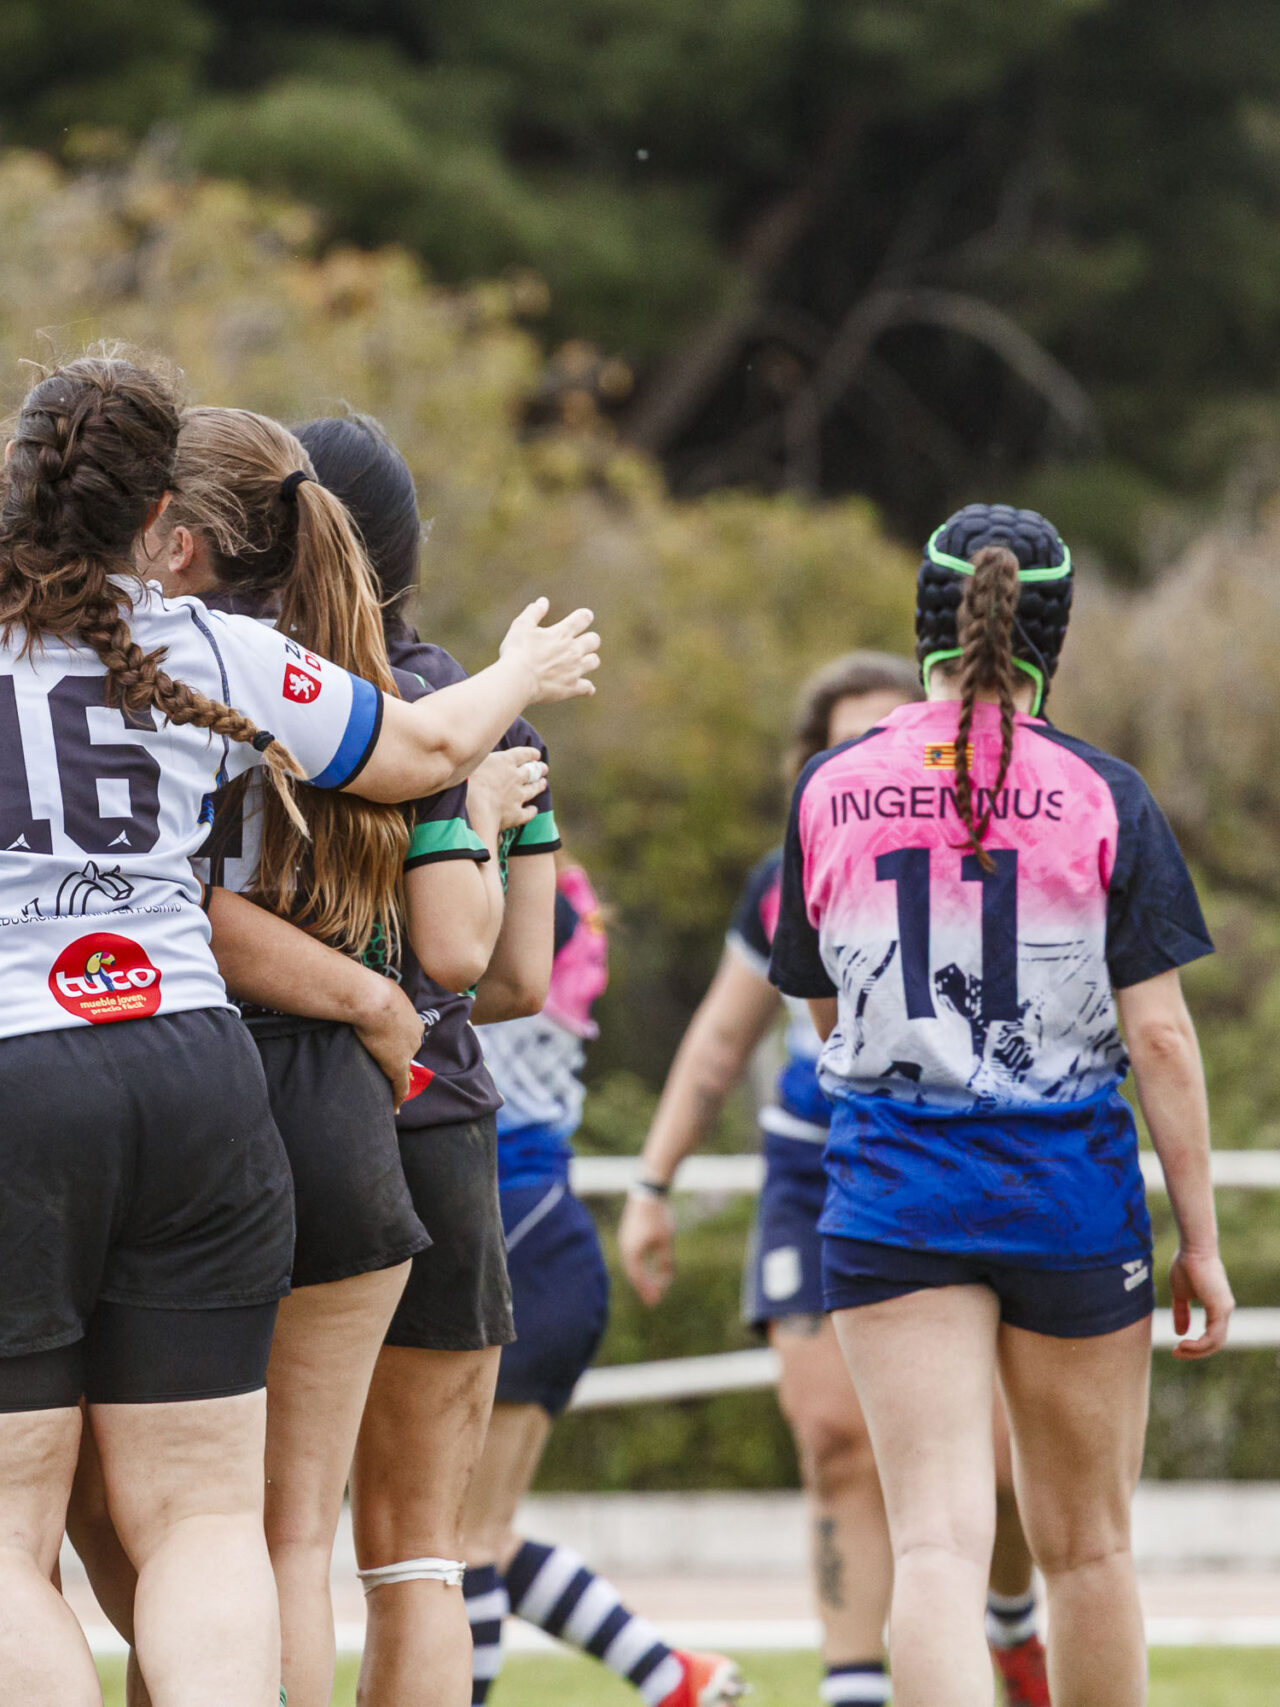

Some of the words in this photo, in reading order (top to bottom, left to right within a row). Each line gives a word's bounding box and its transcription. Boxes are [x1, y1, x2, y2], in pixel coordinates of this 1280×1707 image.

[831, 786, 1064, 827] INGENNUS
[874, 847, 1019, 1021] 11
[56, 967, 157, 998] tuco
